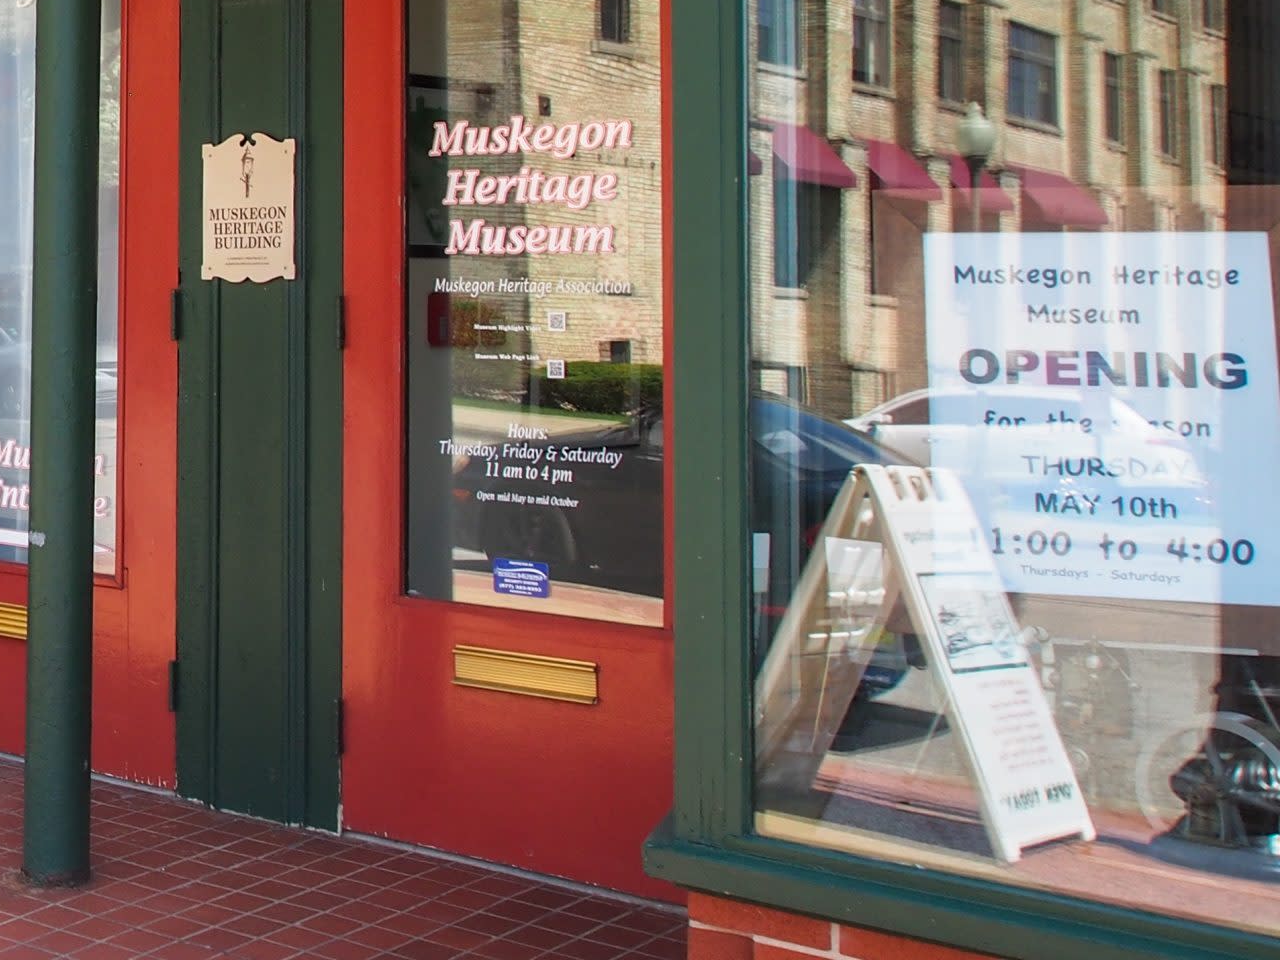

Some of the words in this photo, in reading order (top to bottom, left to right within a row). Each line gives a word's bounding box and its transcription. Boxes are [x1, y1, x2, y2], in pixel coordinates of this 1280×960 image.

[428, 115, 634, 160] Muskegon
[442, 166, 618, 210] Heritage
[209, 205, 288, 221] MUSKEGON
[213, 220, 283, 236] HERITAGE
[444, 218, 614, 256] Museum
[214, 235, 282, 250] BUILDING
[434, 277, 495, 298] Muskegon
[497, 277, 553, 298] Heritage
[555, 278, 632, 295] Association
[953, 263, 1092, 289] Muskegon
[1111, 263, 1240, 290] Heritage
[1027, 304, 1140, 325] Museum
[958, 347, 1249, 390] OPENING
[507, 423, 548, 440] Hours:
[439, 440, 499, 462] Thursday,
[503, 443, 544, 465] Friday
[545, 446, 559, 462] &
[560, 446, 623, 470] Saturday
[485, 462, 499, 478] 11
[502, 466, 523, 479] am
[525, 466, 538, 480] to
[540, 467, 549, 481] 4
[551, 470, 574, 485] pm
[476, 489, 496, 503] Open
[497, 492, 510, 502] mid
[511, 493, 527, 505] May
[527, 495, 535, 504] to
[535, 495, 550, 506] mid
[550, 496, 579, 508] October
[1034, 492, 1101, 516] MAY
[1111, 495, 1178, 519] 10th
[1099, 532, 1138, 561] to
[1167, 536, 1255, 566] 4:00
[1020, 564, 1089, 581] Thursdays
[1110, 568, 1182, 585] Saturdays
